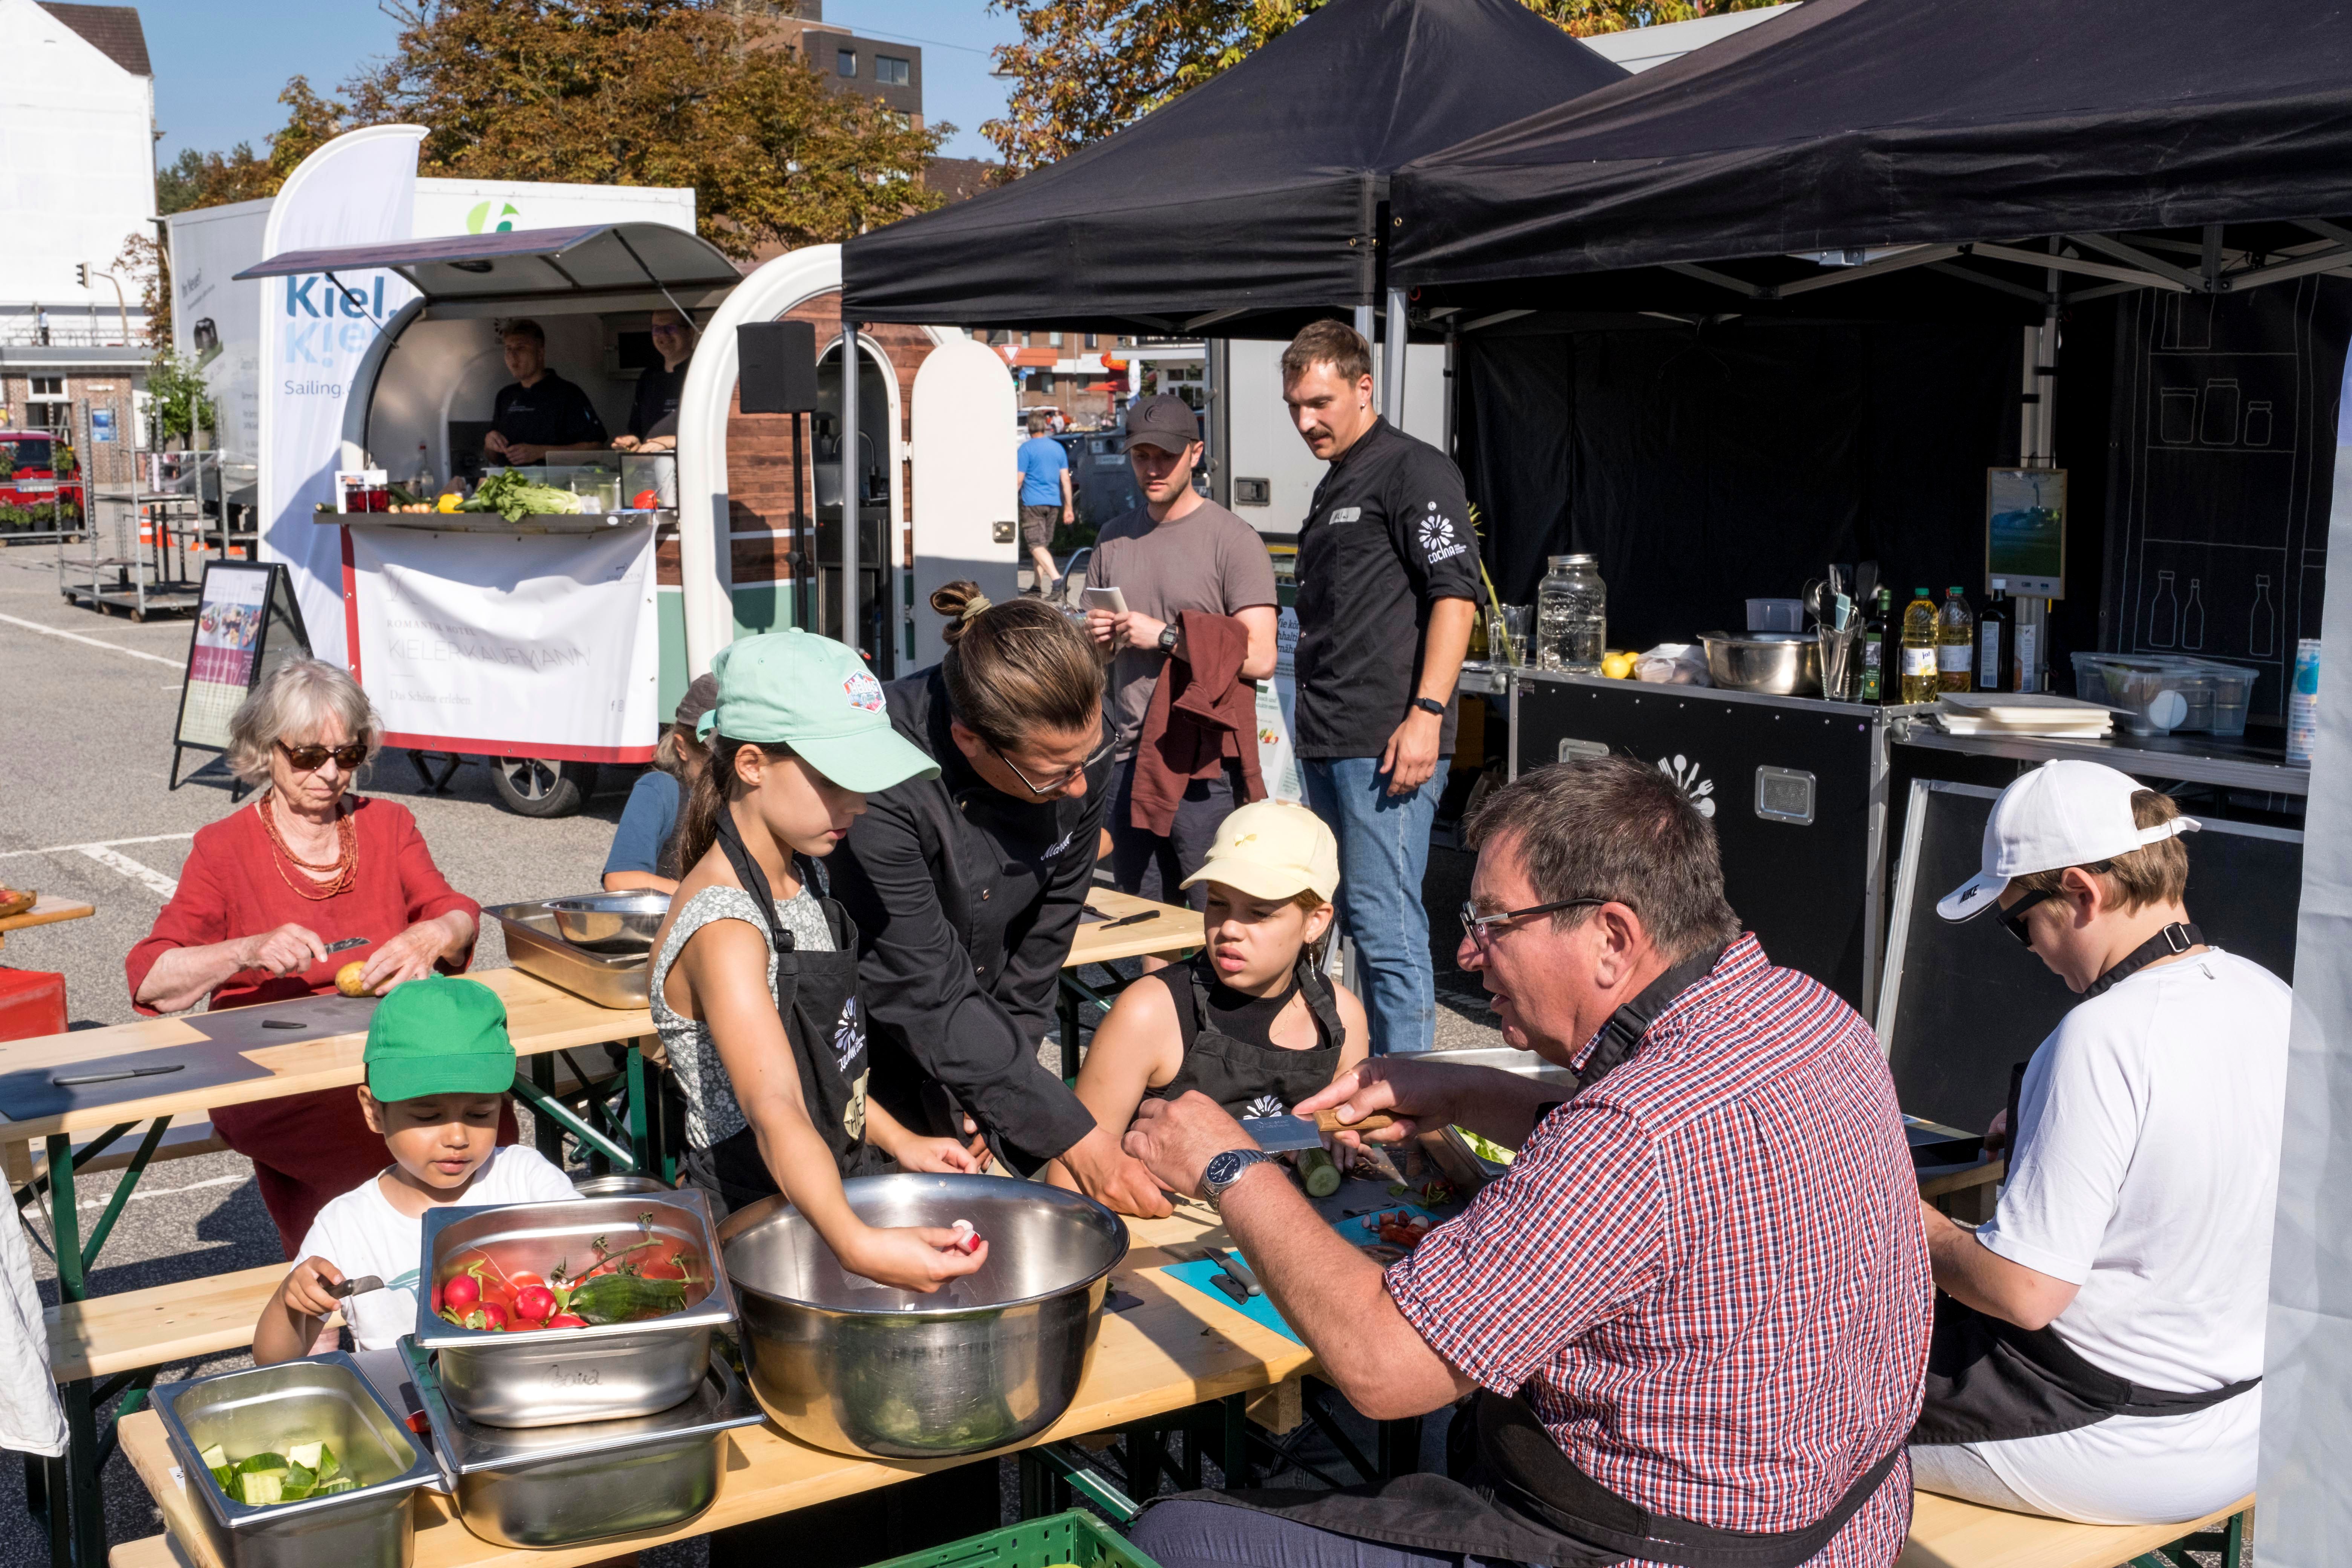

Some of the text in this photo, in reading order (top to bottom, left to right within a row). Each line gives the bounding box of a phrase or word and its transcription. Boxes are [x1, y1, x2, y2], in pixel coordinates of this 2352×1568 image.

[287, 276, 398, 319] Kiel.
[387, 619, 477, 637] ROMANTIK HOTEL
[388, 638, 592, 674] KIELER KAUFMANN
[390, 690, 474, 706] Das Schöne erleben.
[1959, 884, 1980, 904] NIKE
